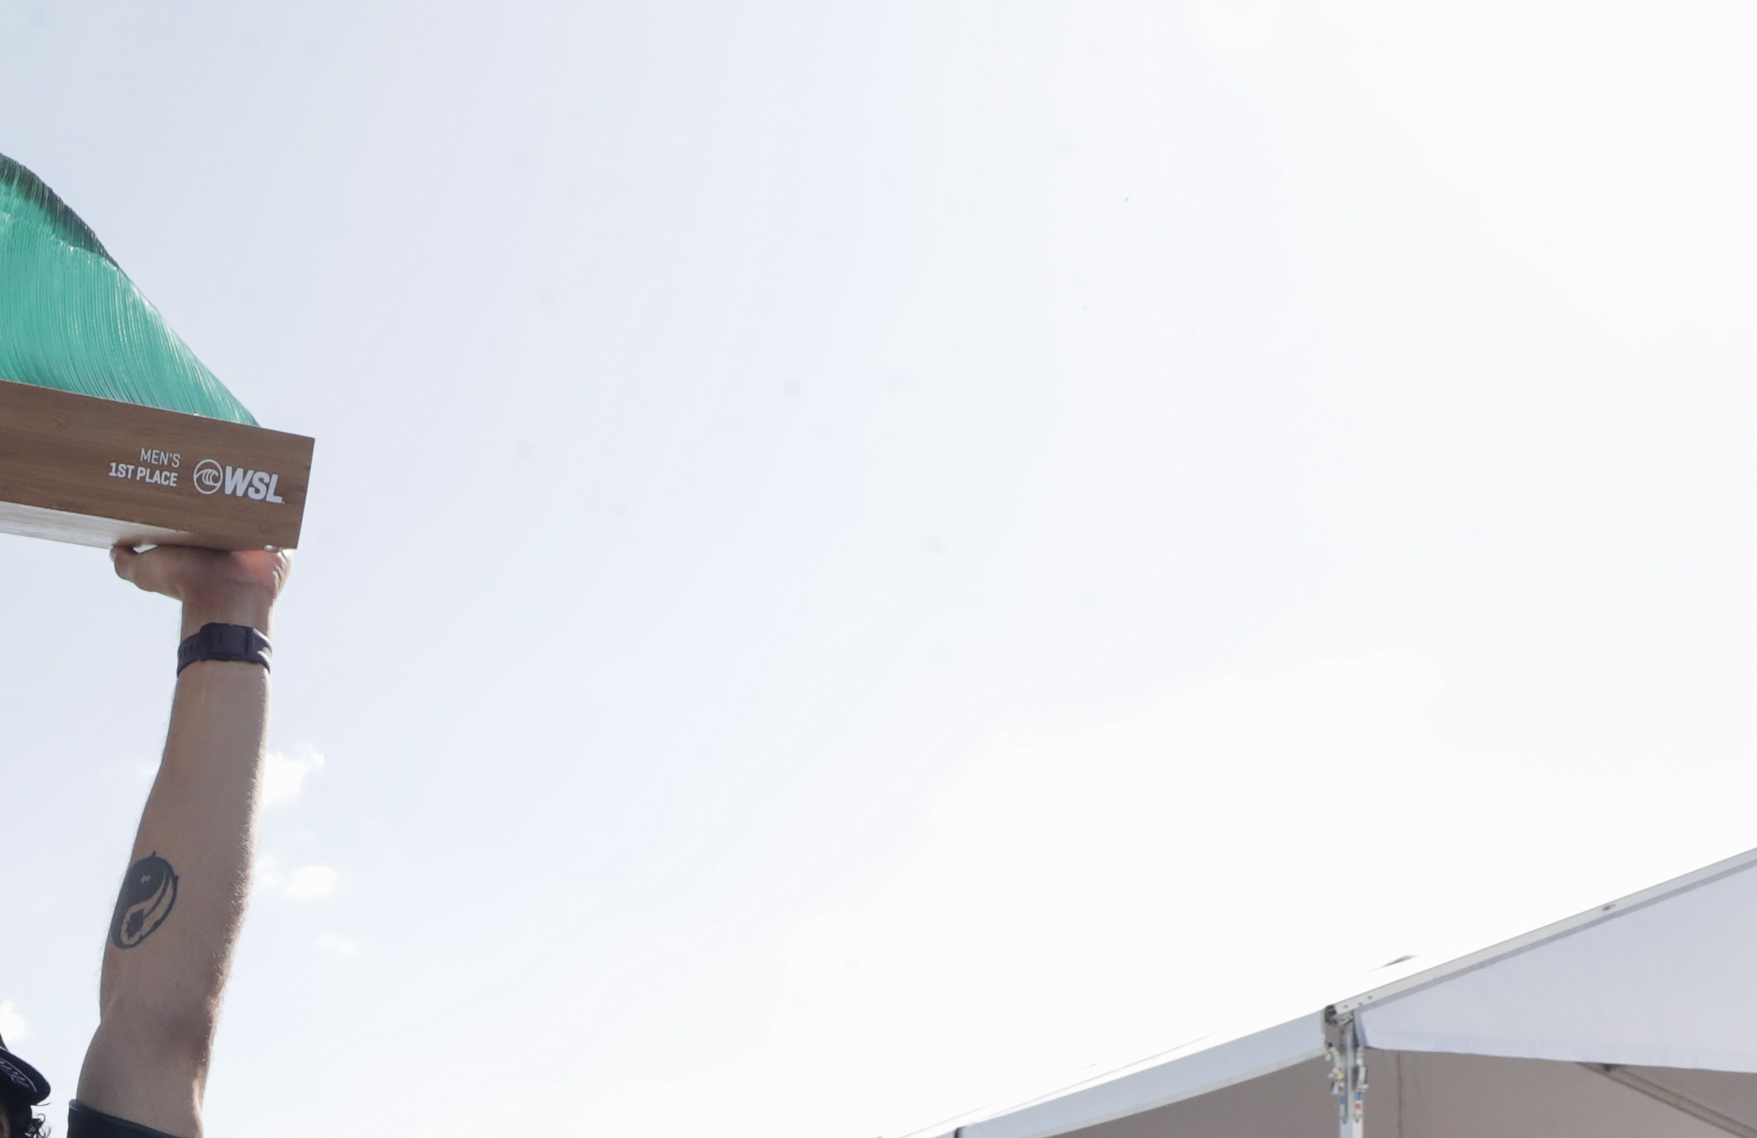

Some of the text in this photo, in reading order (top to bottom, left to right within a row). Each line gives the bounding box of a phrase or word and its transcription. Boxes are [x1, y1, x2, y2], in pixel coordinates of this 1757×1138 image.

[140, 448, 181, 468] MEN'S
[108, 462, 179, 487] 1ST PLACE
[224, 465, 283, 504] WSL
